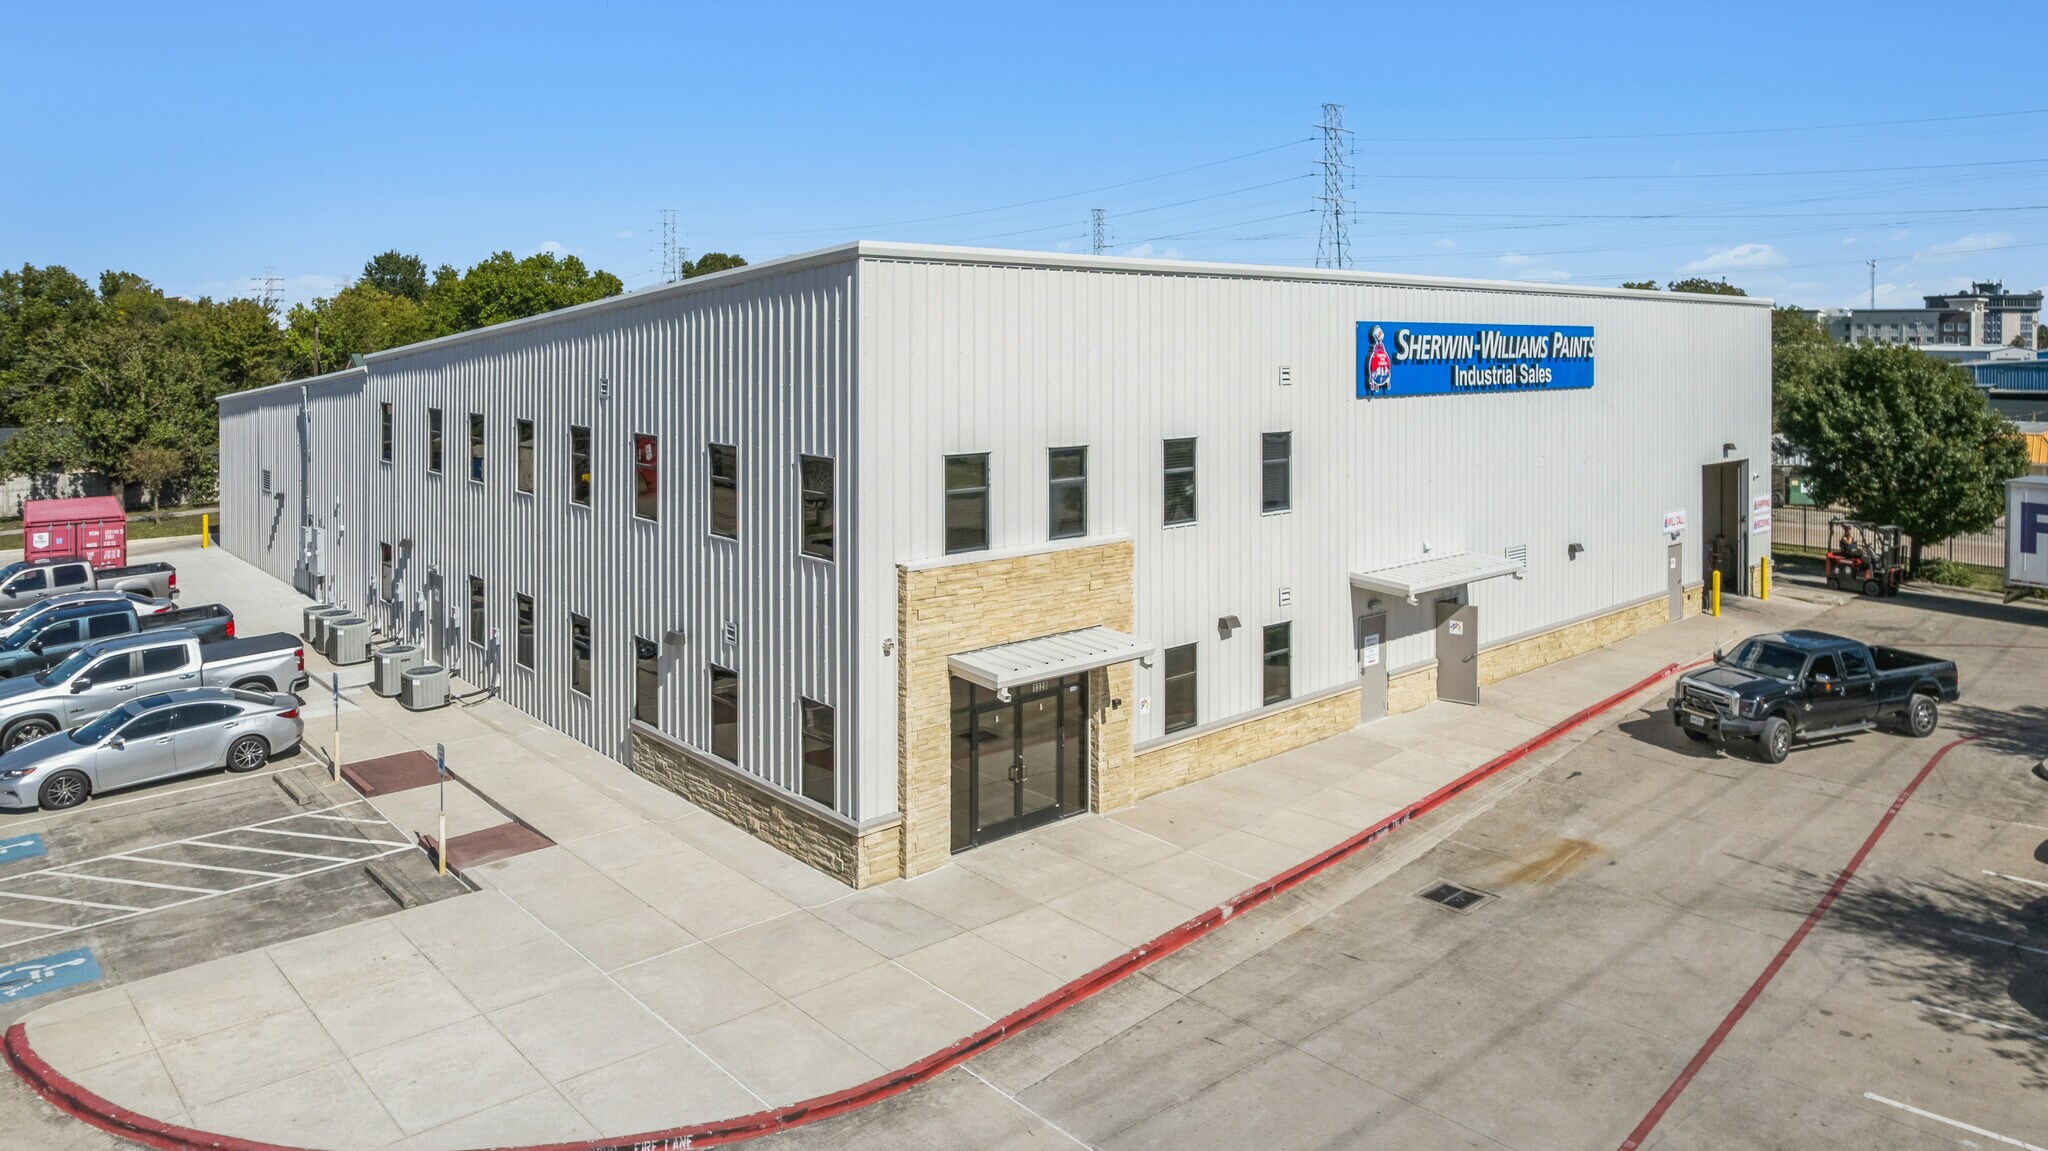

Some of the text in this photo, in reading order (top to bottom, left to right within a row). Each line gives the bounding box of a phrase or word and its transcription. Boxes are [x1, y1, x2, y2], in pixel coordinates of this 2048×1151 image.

[1397, 328, 1548, 361] SHERWIN-WILLIAMS
[1553, 331, 1595, 359] PAINTS
[1455, 363, 1552, 387] Industrial Sales
[633, 1140, 659, 1151] FIRE
[664, 1134, 694, 1151] LANE
